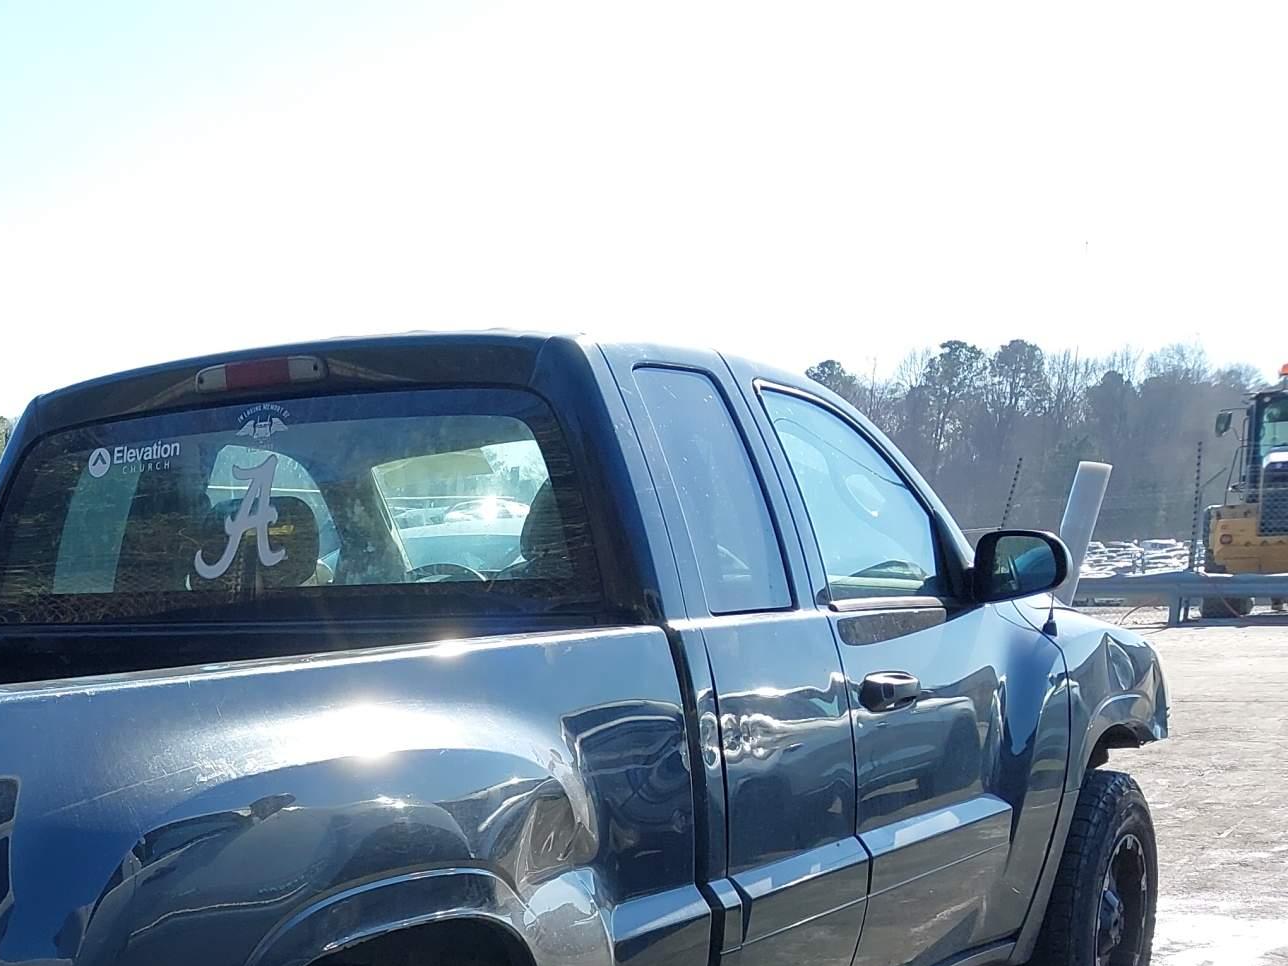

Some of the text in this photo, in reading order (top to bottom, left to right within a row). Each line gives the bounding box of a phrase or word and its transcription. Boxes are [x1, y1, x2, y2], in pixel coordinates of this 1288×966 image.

[113, 440, 180, 465] Elevation
[122, 460, 170, 475] CHURCH
[194, 453, 287, 580] A
